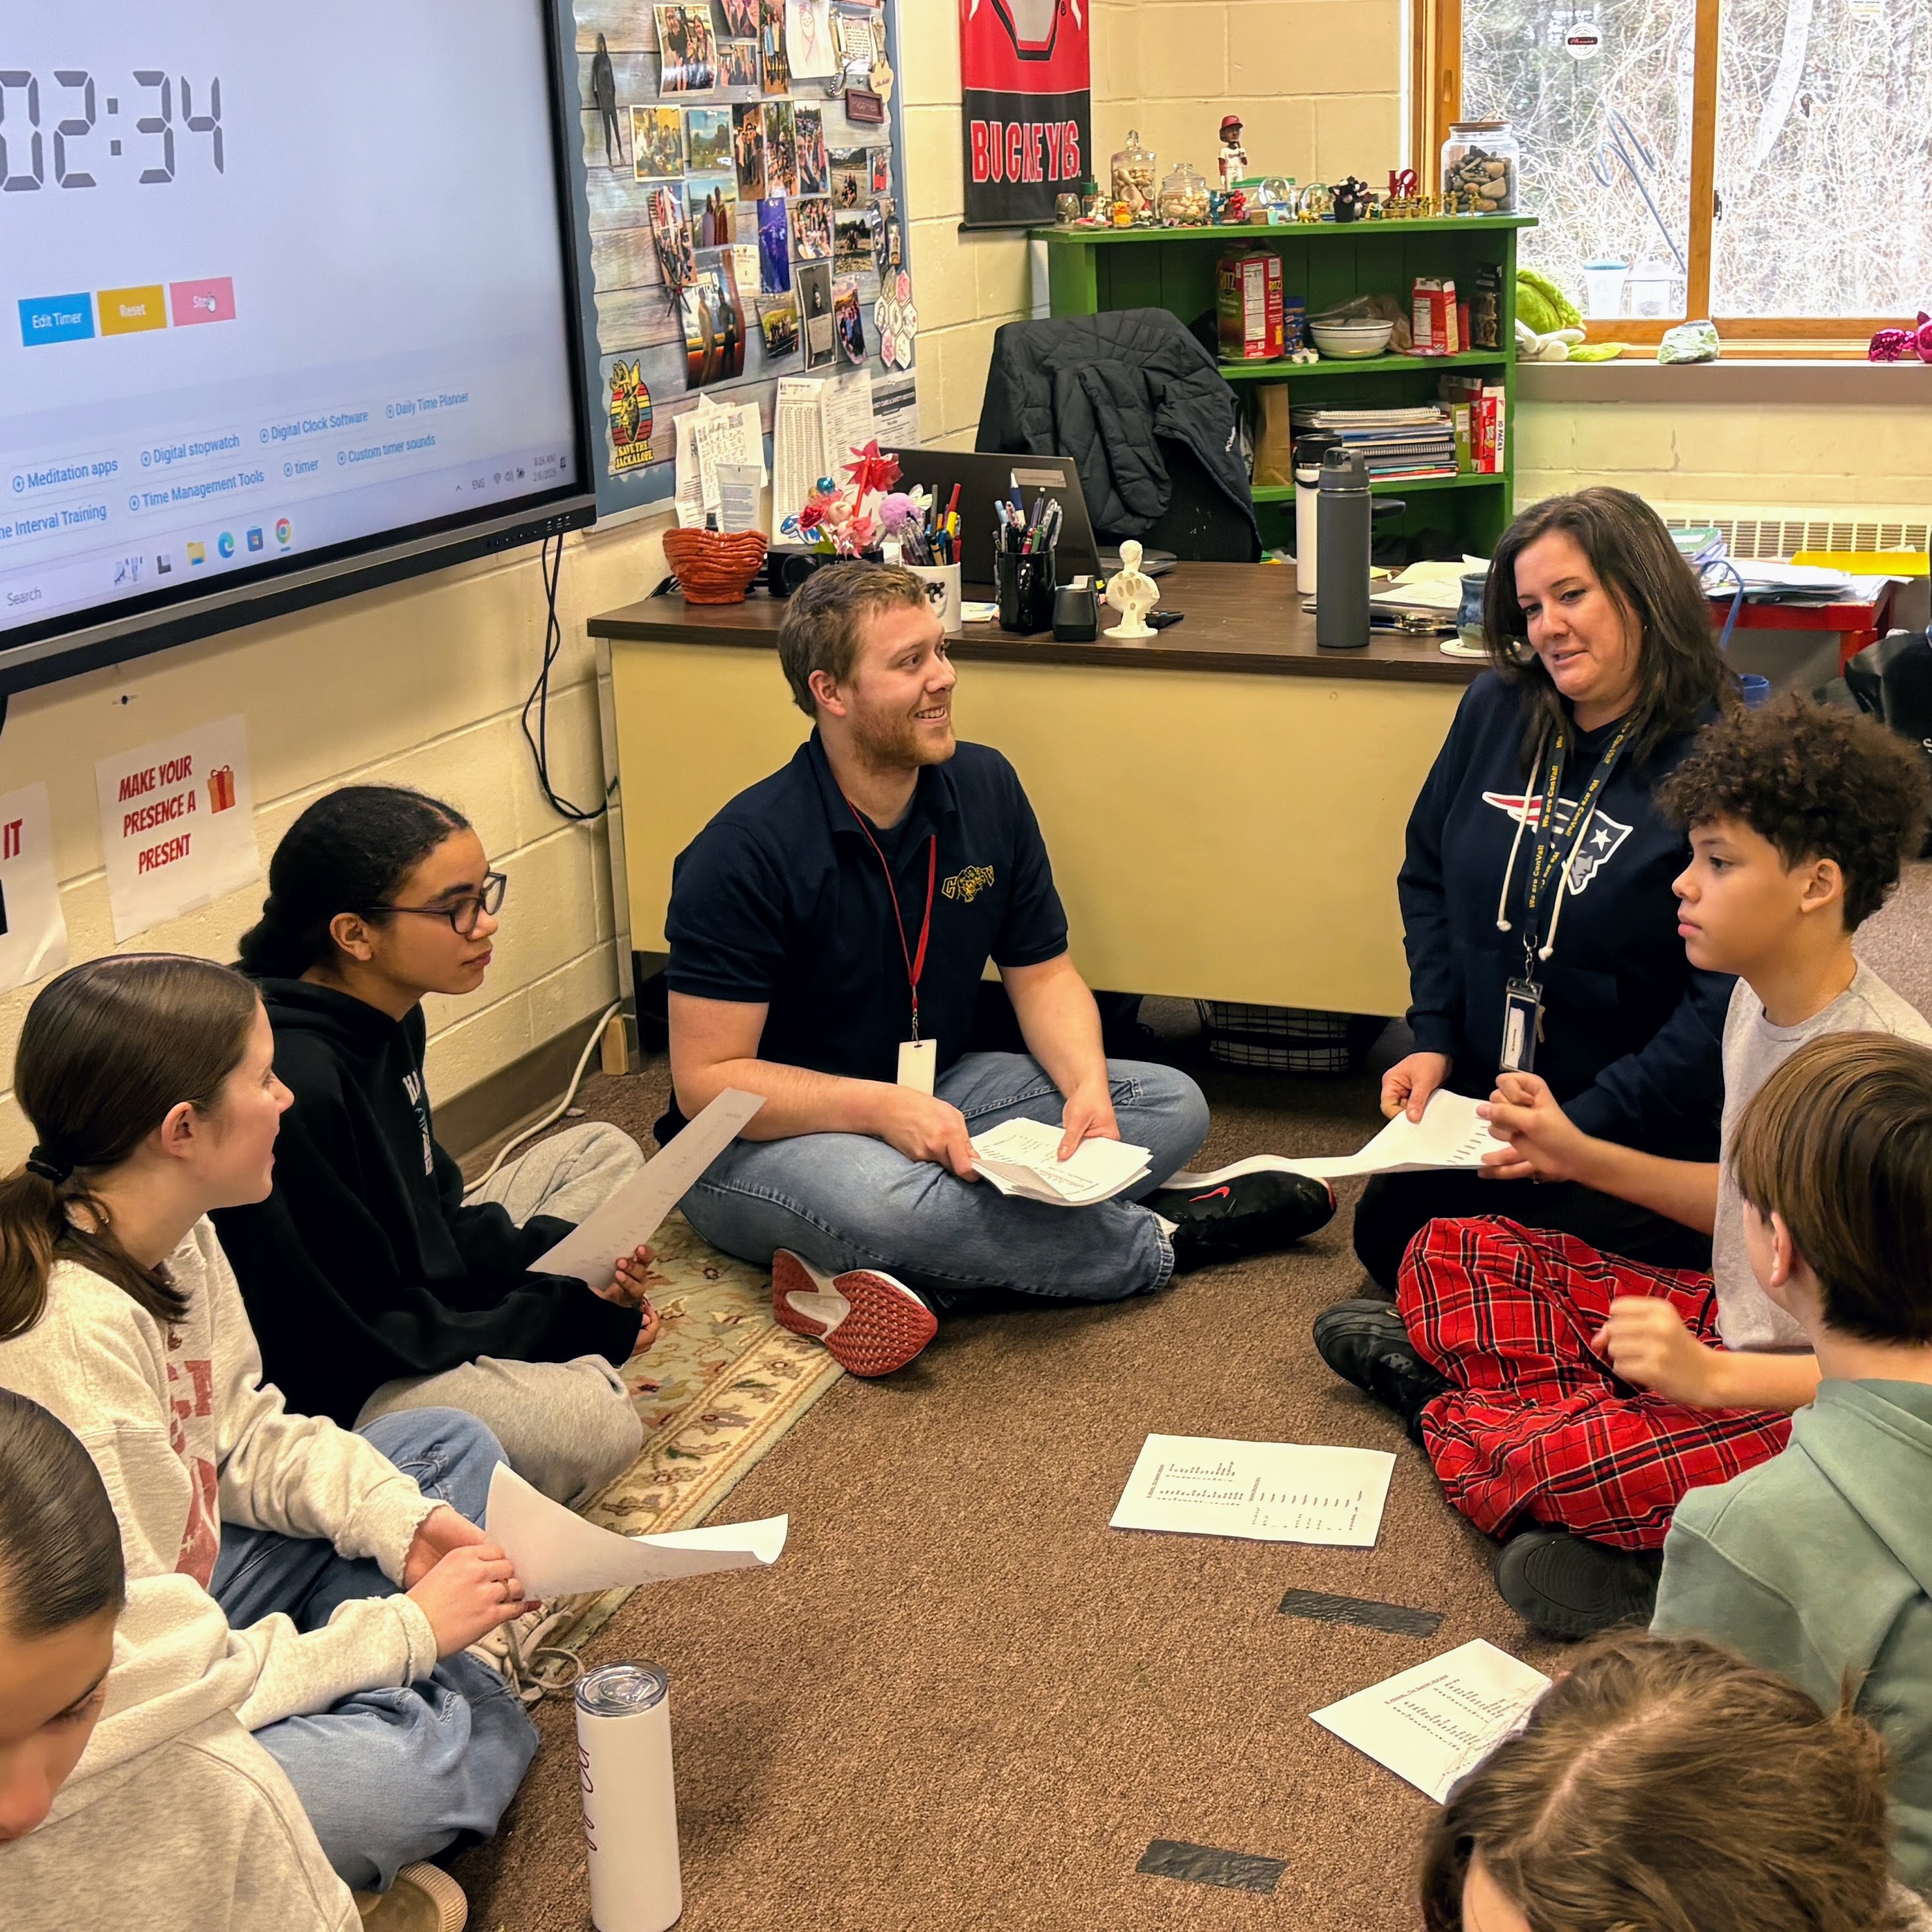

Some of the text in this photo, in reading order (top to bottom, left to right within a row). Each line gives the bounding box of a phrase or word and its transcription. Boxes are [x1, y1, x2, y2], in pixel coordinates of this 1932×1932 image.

[0, 70, 224, 191] 02:34
[32, 312, 82, 329] Edit Timer
[119, 304, 146, 318] Reset
[396, 392, 469, 416] Daily Time Planner
[271, 410, 369, 441] Digital Clock Software
[154, 433, 240, 464] Digital stopwatch
[349, 434, 436, 463] Custom timer sounds
[616, 449, 654, 468] JACKALOPE
[618, 440, 648, 457] SAVE THE
[27, 459, 118, 488] Meditation apps
[295, 459, 319, 474] timer
[142, 470, 265, 507] Time Management Tools
[15, 511, 59, 536] Interval
[62, 504, 107, 528] Training
[7, 587, 42, 606] Search
[118, 755, 192, 802] MAKE YOUR
[123, 789, 197, 838] PRESENCE A
[3, 818, 23, 859] IT
[138, 832, 192, 875] PRESENT
